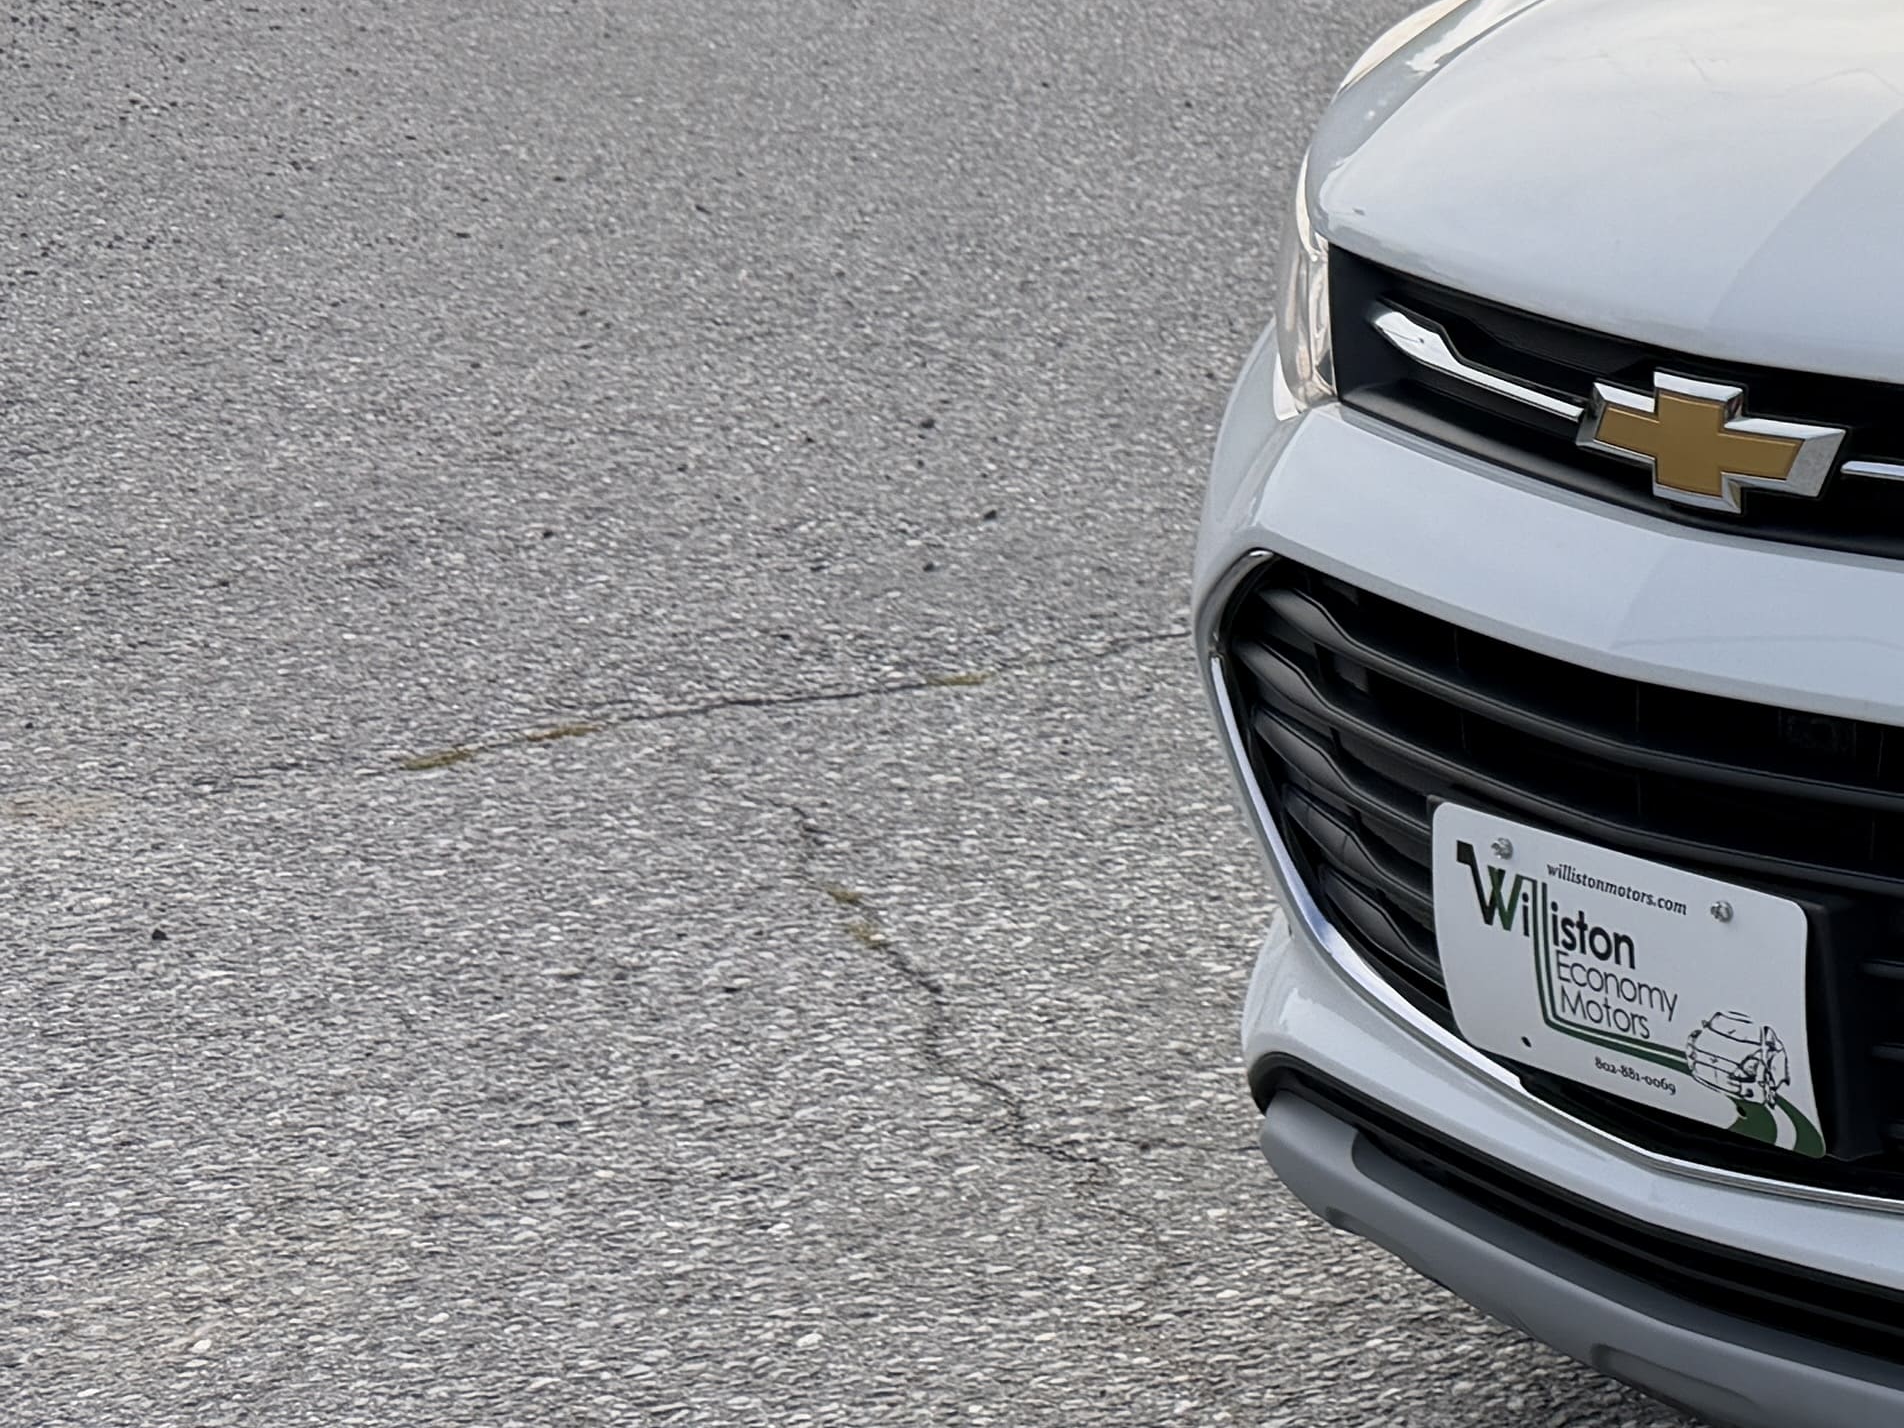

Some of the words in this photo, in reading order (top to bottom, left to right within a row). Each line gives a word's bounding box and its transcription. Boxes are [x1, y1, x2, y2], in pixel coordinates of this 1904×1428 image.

[1457, 840, 1636, 969] Williston
[1547, 863, 1687, 915] willistonmotors.com
[1556, 951, 1678, 1021] Economy
[1560, 987, 1650, 1039] Motors
[1595, 1056, 1676, 1096] 802-881-0069
